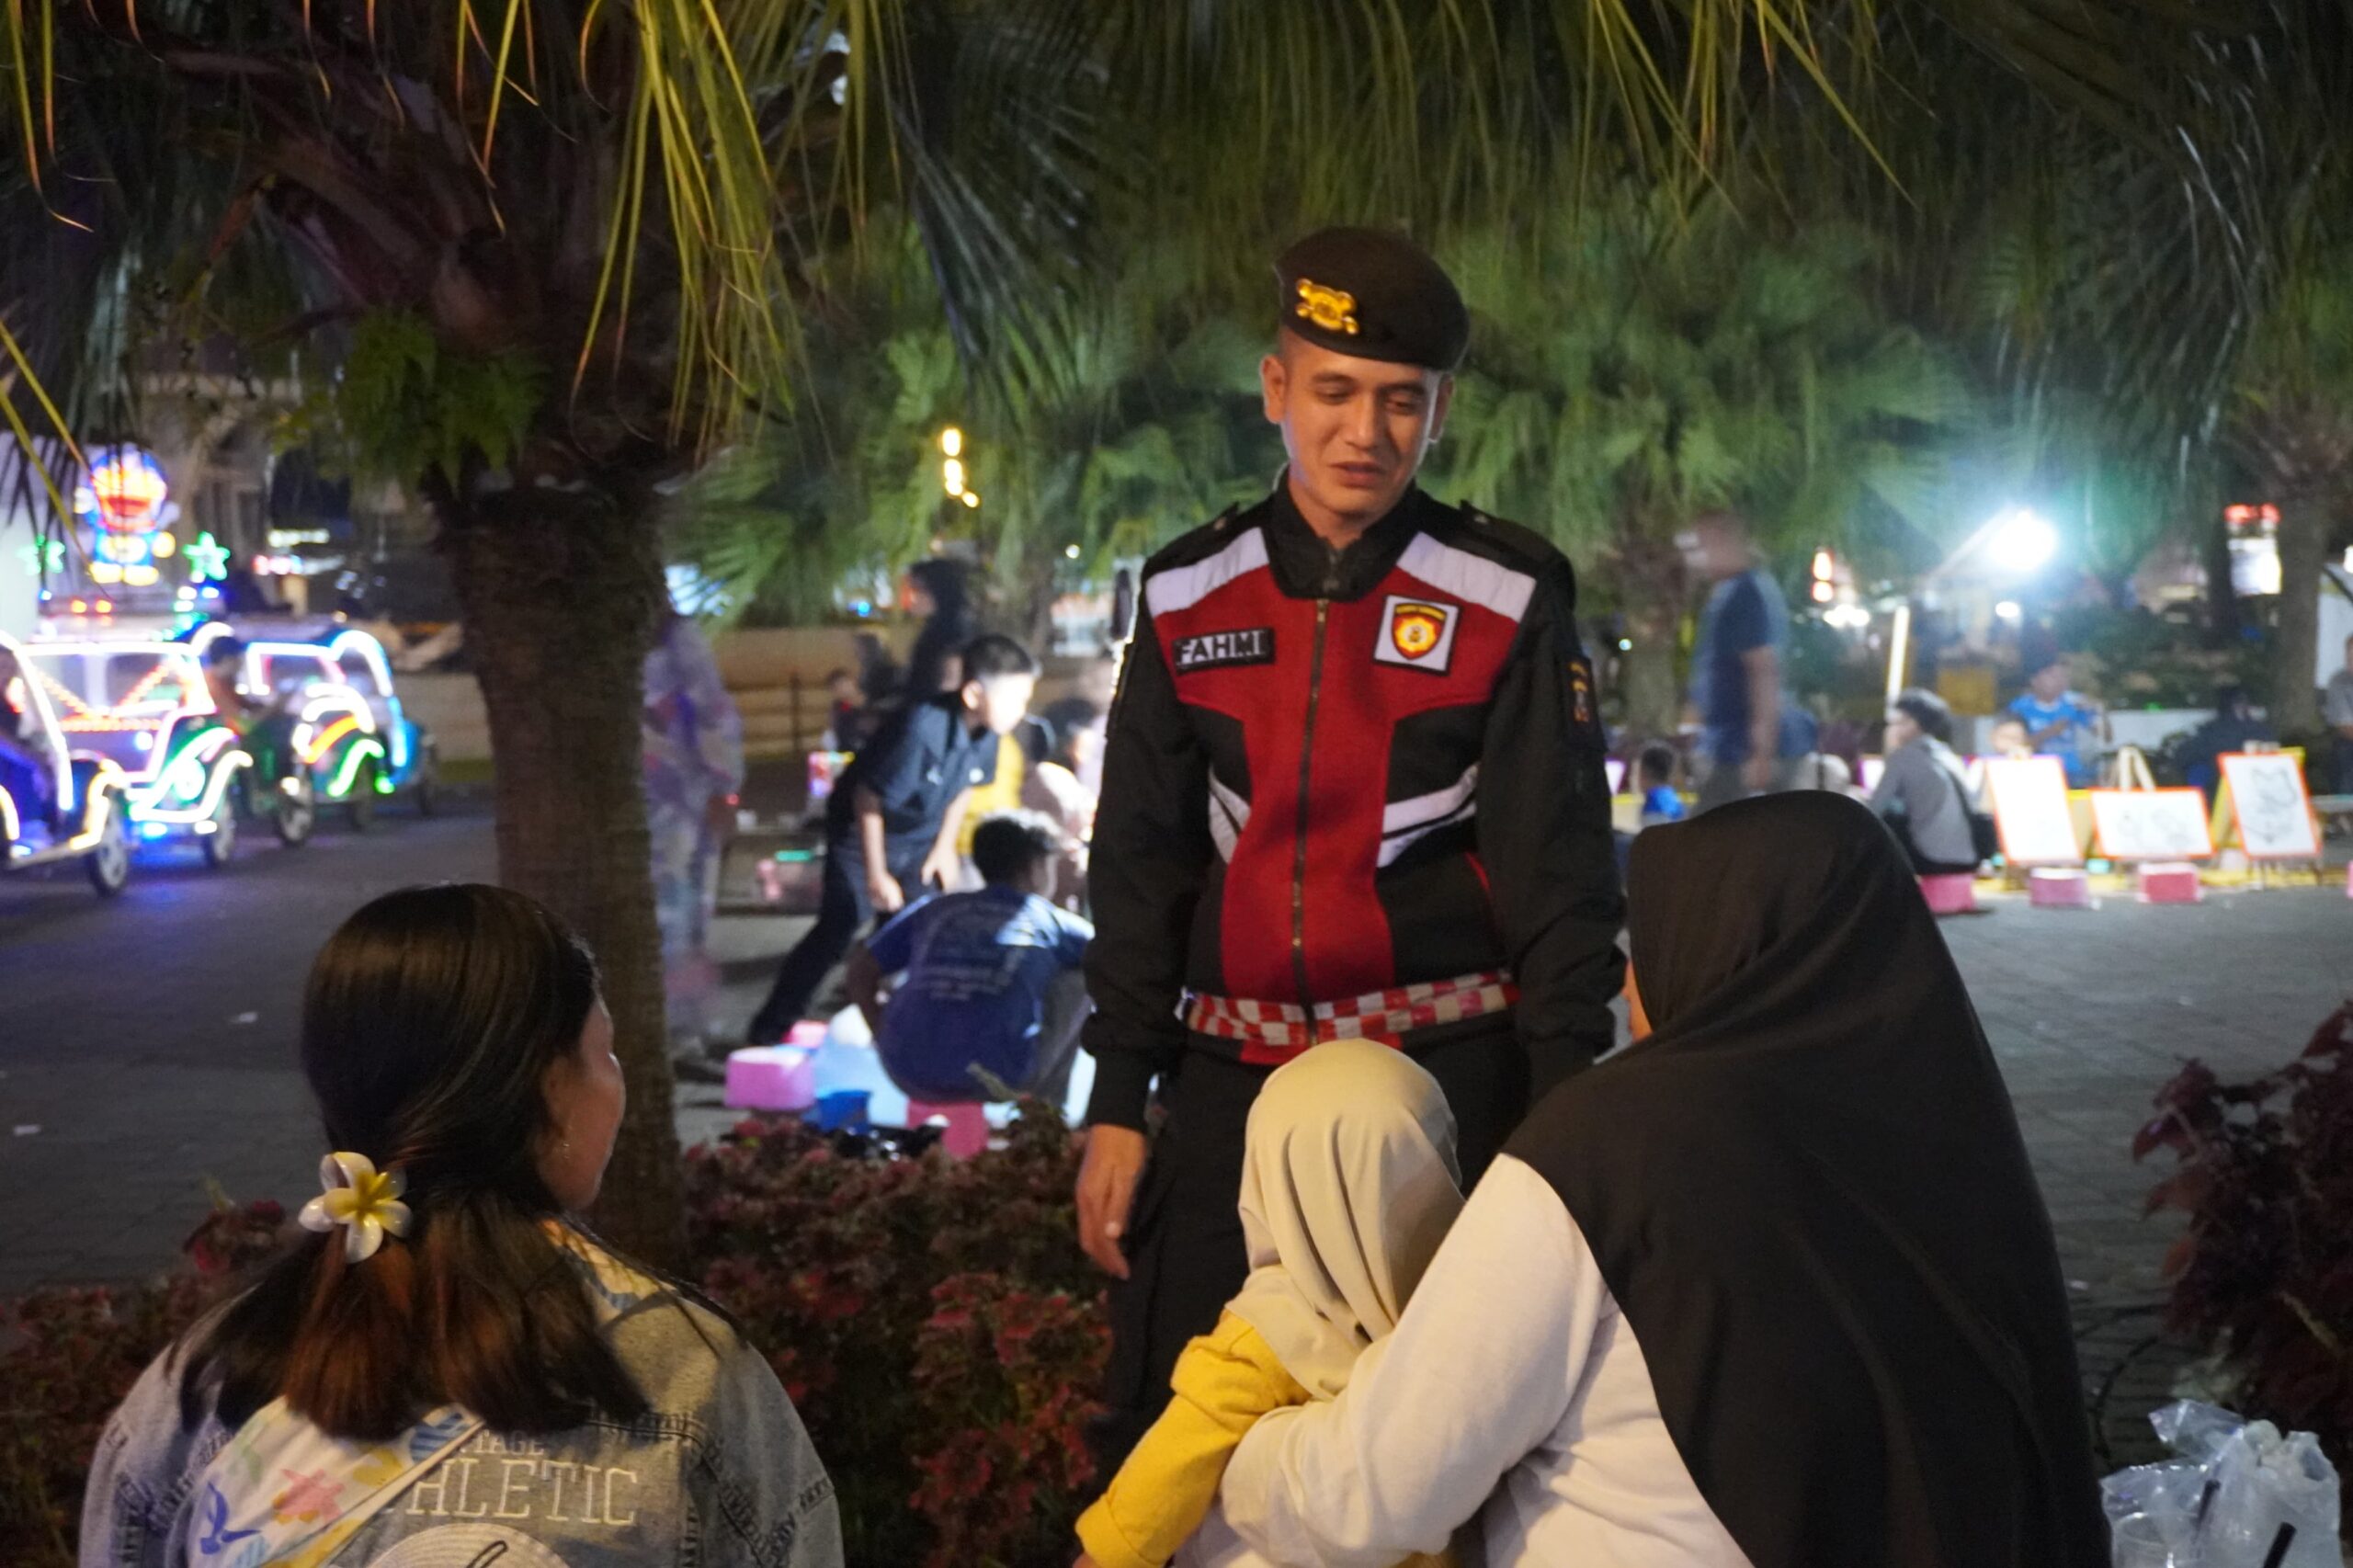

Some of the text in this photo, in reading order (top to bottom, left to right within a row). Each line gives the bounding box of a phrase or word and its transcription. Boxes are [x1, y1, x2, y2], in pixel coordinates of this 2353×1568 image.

[1176, 630, 1267, 665] FAHMI
[460, 1428, 545, 1456] TAGE
[386, 1458, 637, 1526] HLETIC
